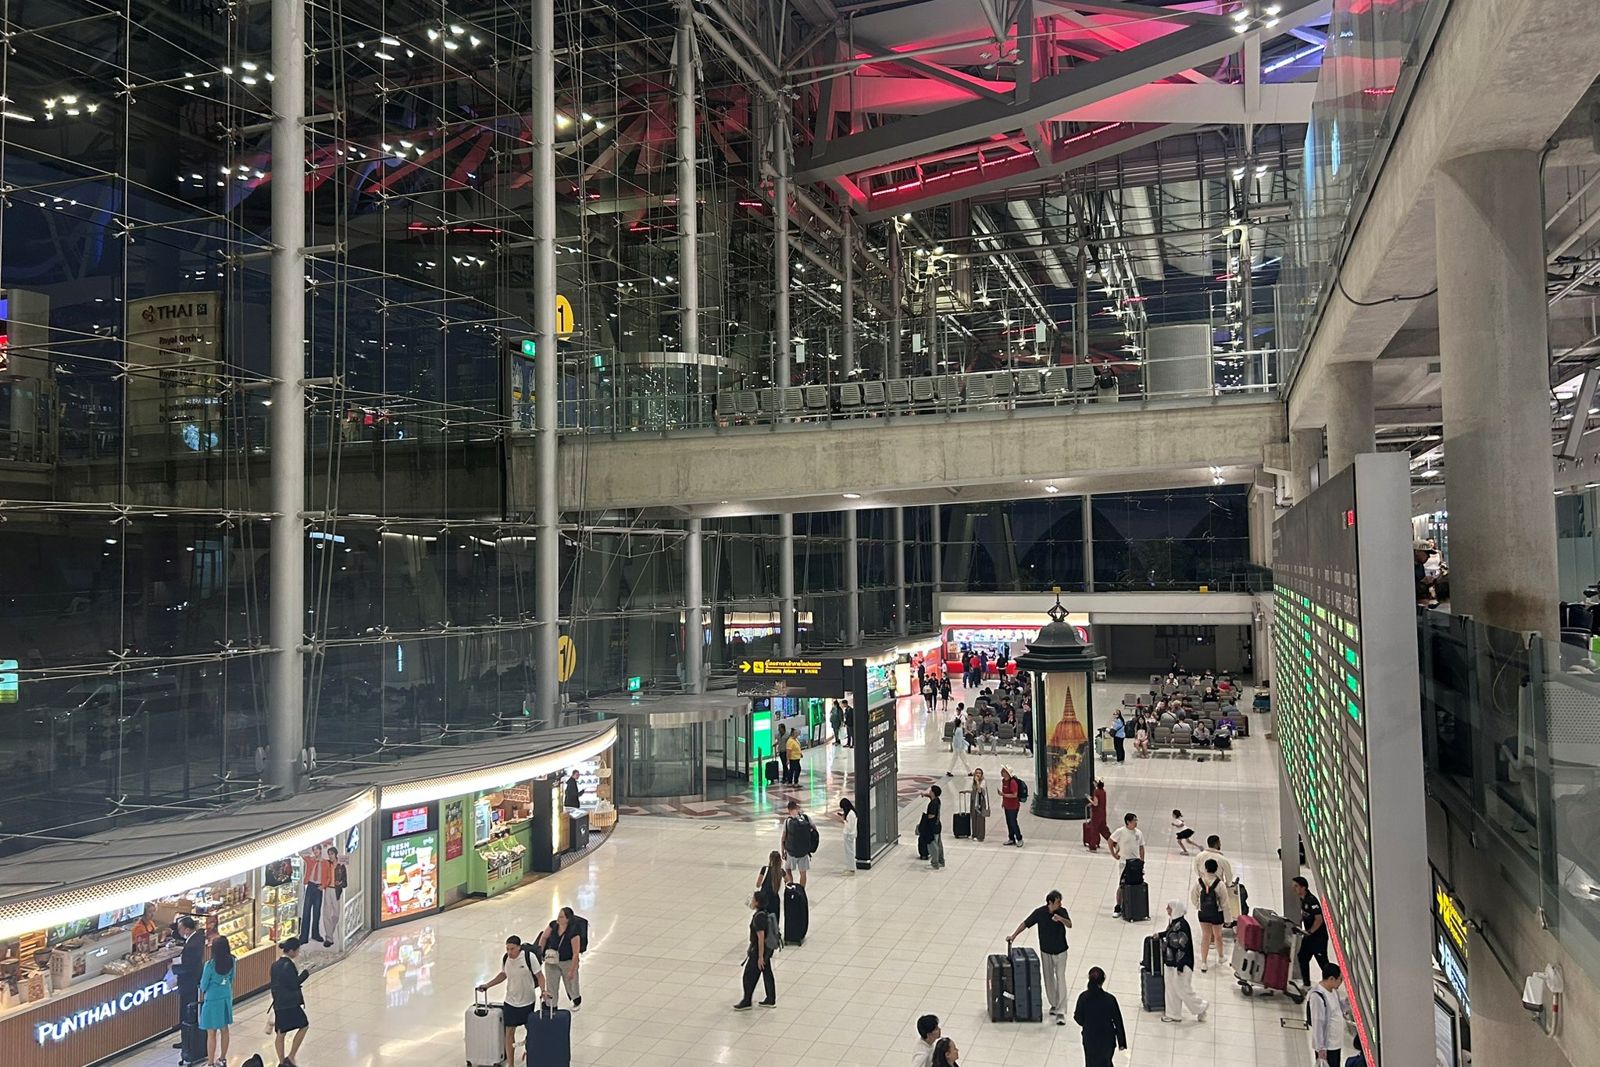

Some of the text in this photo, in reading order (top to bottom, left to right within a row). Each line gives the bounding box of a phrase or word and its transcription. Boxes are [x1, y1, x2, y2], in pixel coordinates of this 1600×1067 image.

[157, 304, 193, 319] THAI
[557, 305, 564, 332] 1
[387, 841, 410, 853] FRESH
[391, 846, 417, 858] FRUITS
[38, 1000, 117, 1046] PUNTHAI
